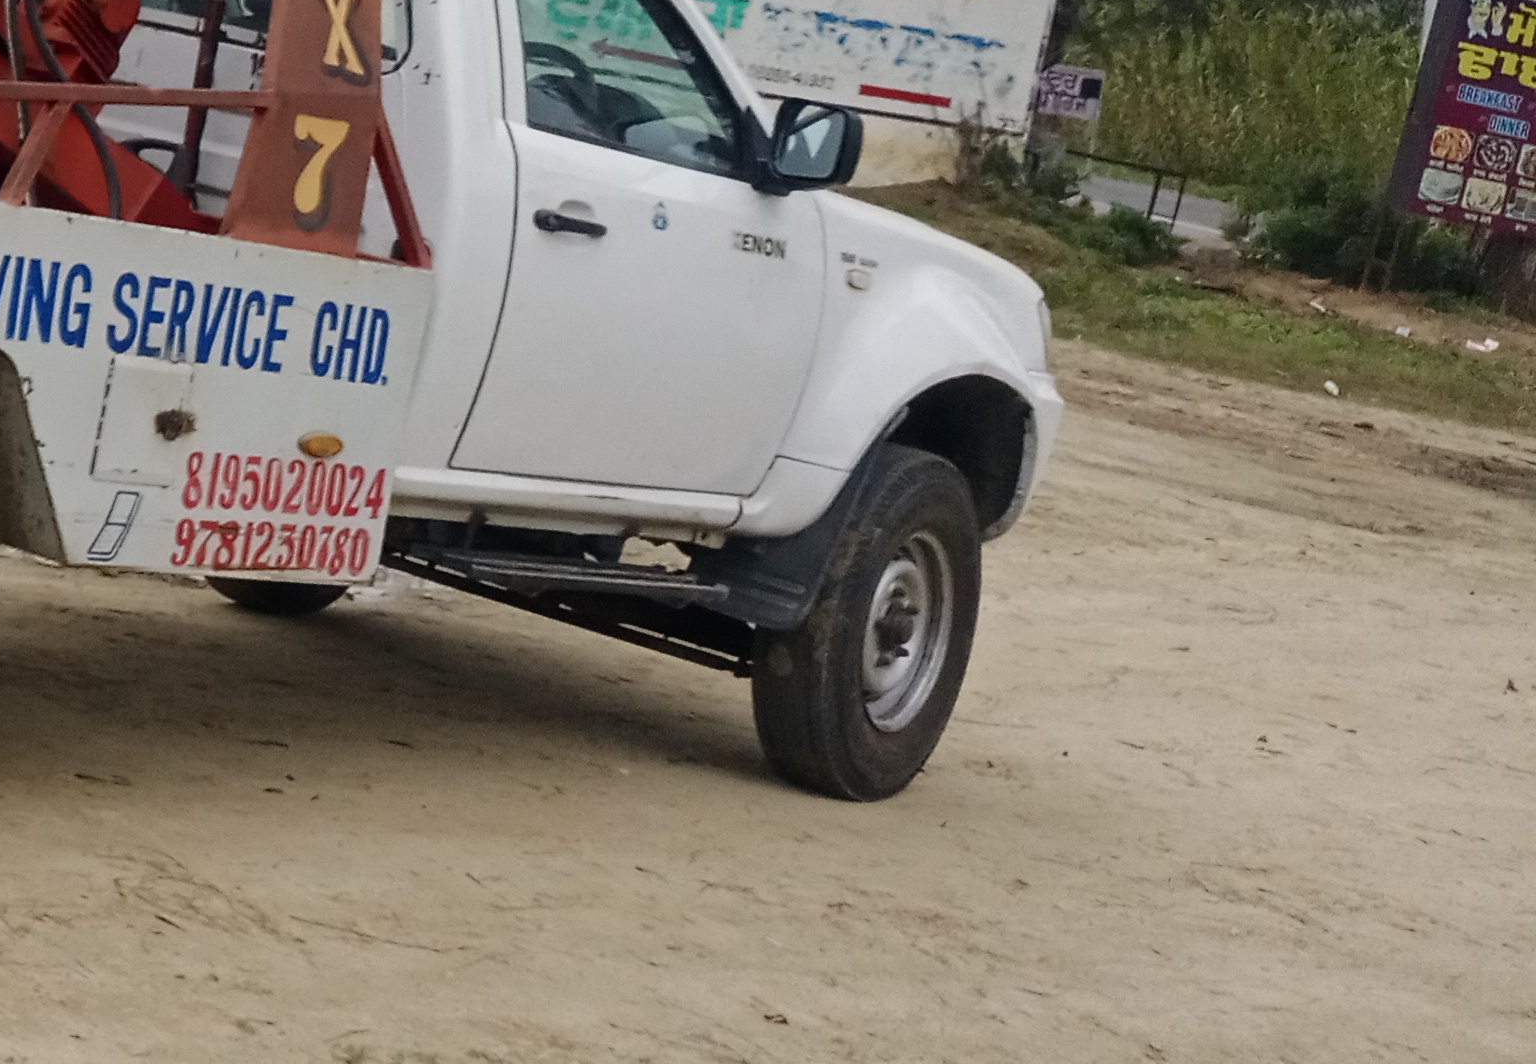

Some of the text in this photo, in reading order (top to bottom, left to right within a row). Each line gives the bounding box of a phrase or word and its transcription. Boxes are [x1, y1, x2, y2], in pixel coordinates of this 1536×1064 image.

[1456, 83, 1524, 114] BREAKFAST
[1486, 114, 1530, 140] DINNER
[293, 113, 351, 221] 7
[105, 271, 295, 374] SERVICE
[181, 450, 388, 521] 8195020024
